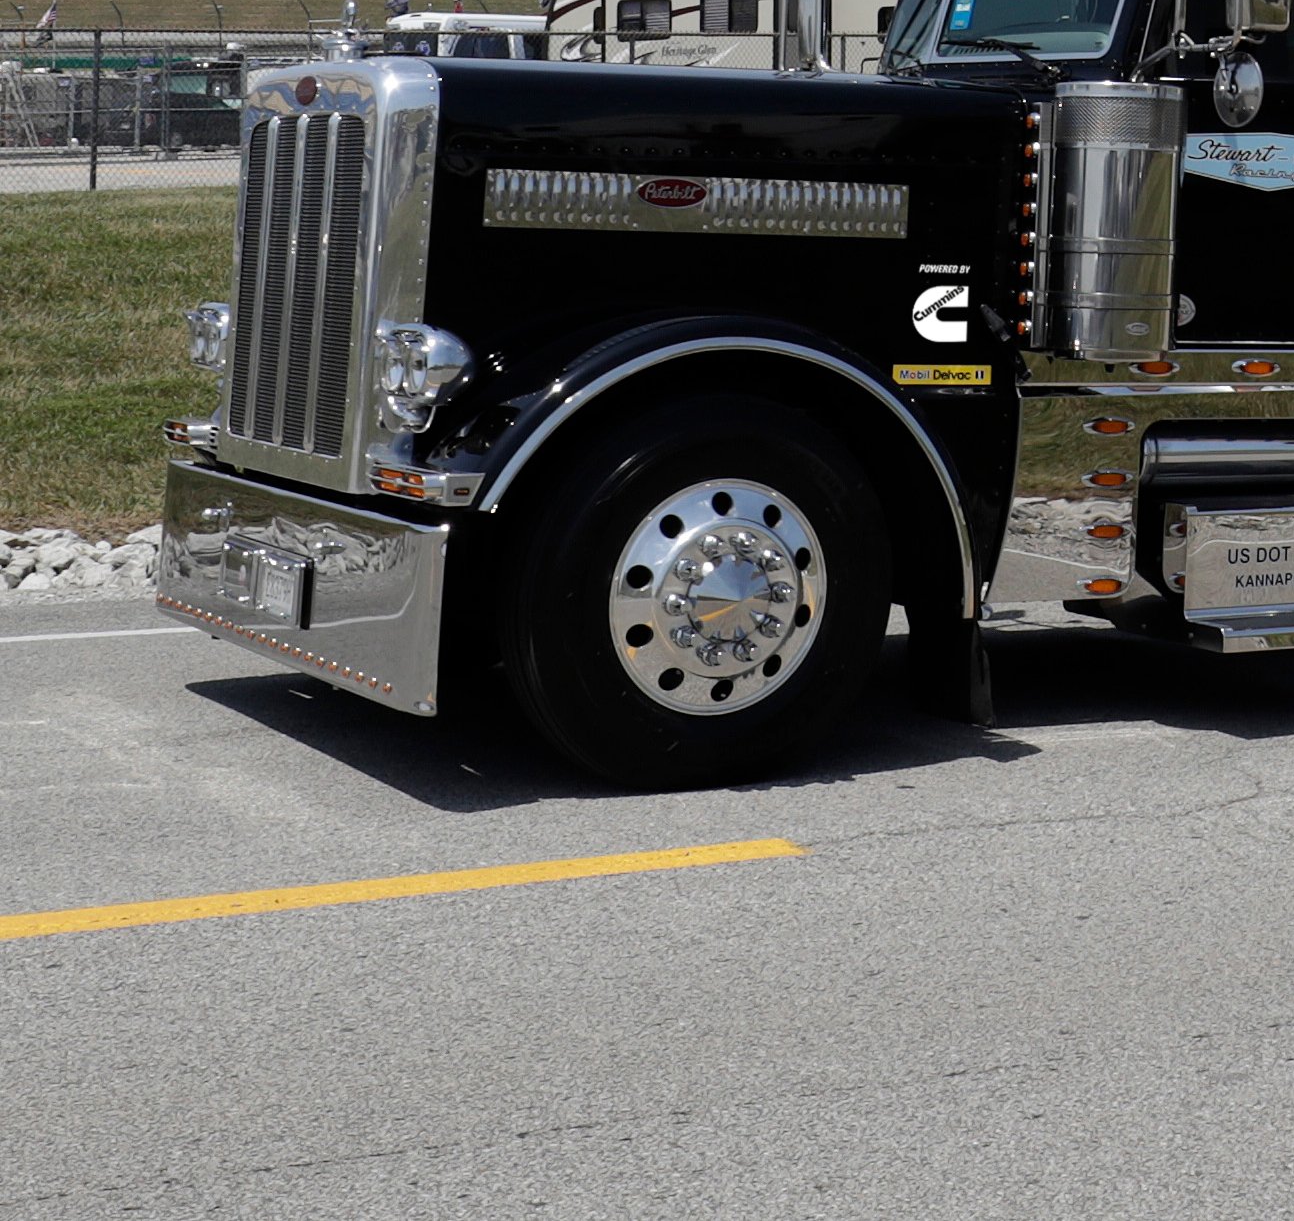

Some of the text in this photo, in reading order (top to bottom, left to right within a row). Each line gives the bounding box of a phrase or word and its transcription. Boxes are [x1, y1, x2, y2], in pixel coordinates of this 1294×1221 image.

[1187, 139, 1283, 162] Stewart
[644, 182, 701, 199] Peterbilt
[919, 264, 970, 274] POWERED BY
[913, 285, 965, 322] Cummins
[899, 370, 930, 380] Mobil
[933, 369, 971, 381] Delvac
[1228, 548, 1250, 564] US
[1256, 546, 1291, 562] DOT
